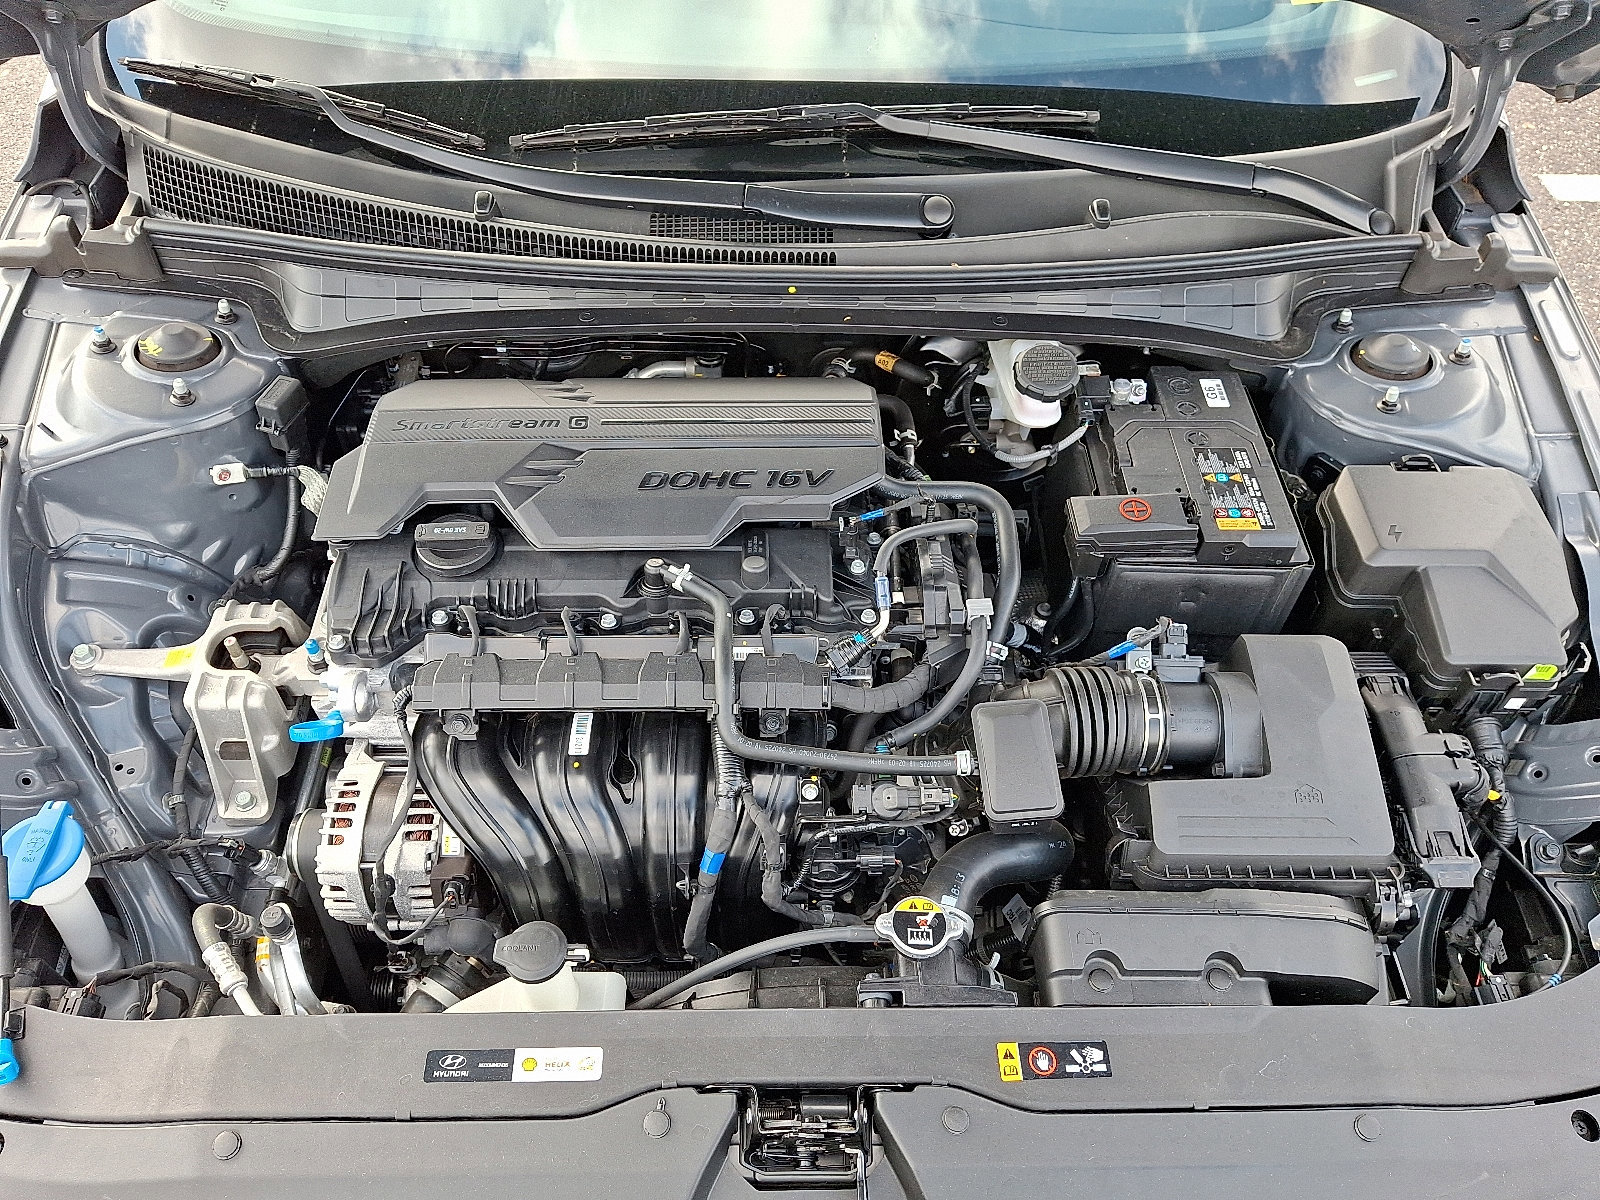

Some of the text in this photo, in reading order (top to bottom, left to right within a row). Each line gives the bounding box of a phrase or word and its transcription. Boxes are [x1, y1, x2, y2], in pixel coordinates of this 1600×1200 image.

[391, 415, 589, 432] Smartstream G
[637, 468, 835, 491] DOHC 16V
[501, 944, 540, 952] COOLANT
[545, 1061, 571, 1069] HELIX
[433, 1070, 469, 1078] HYUNDAI
